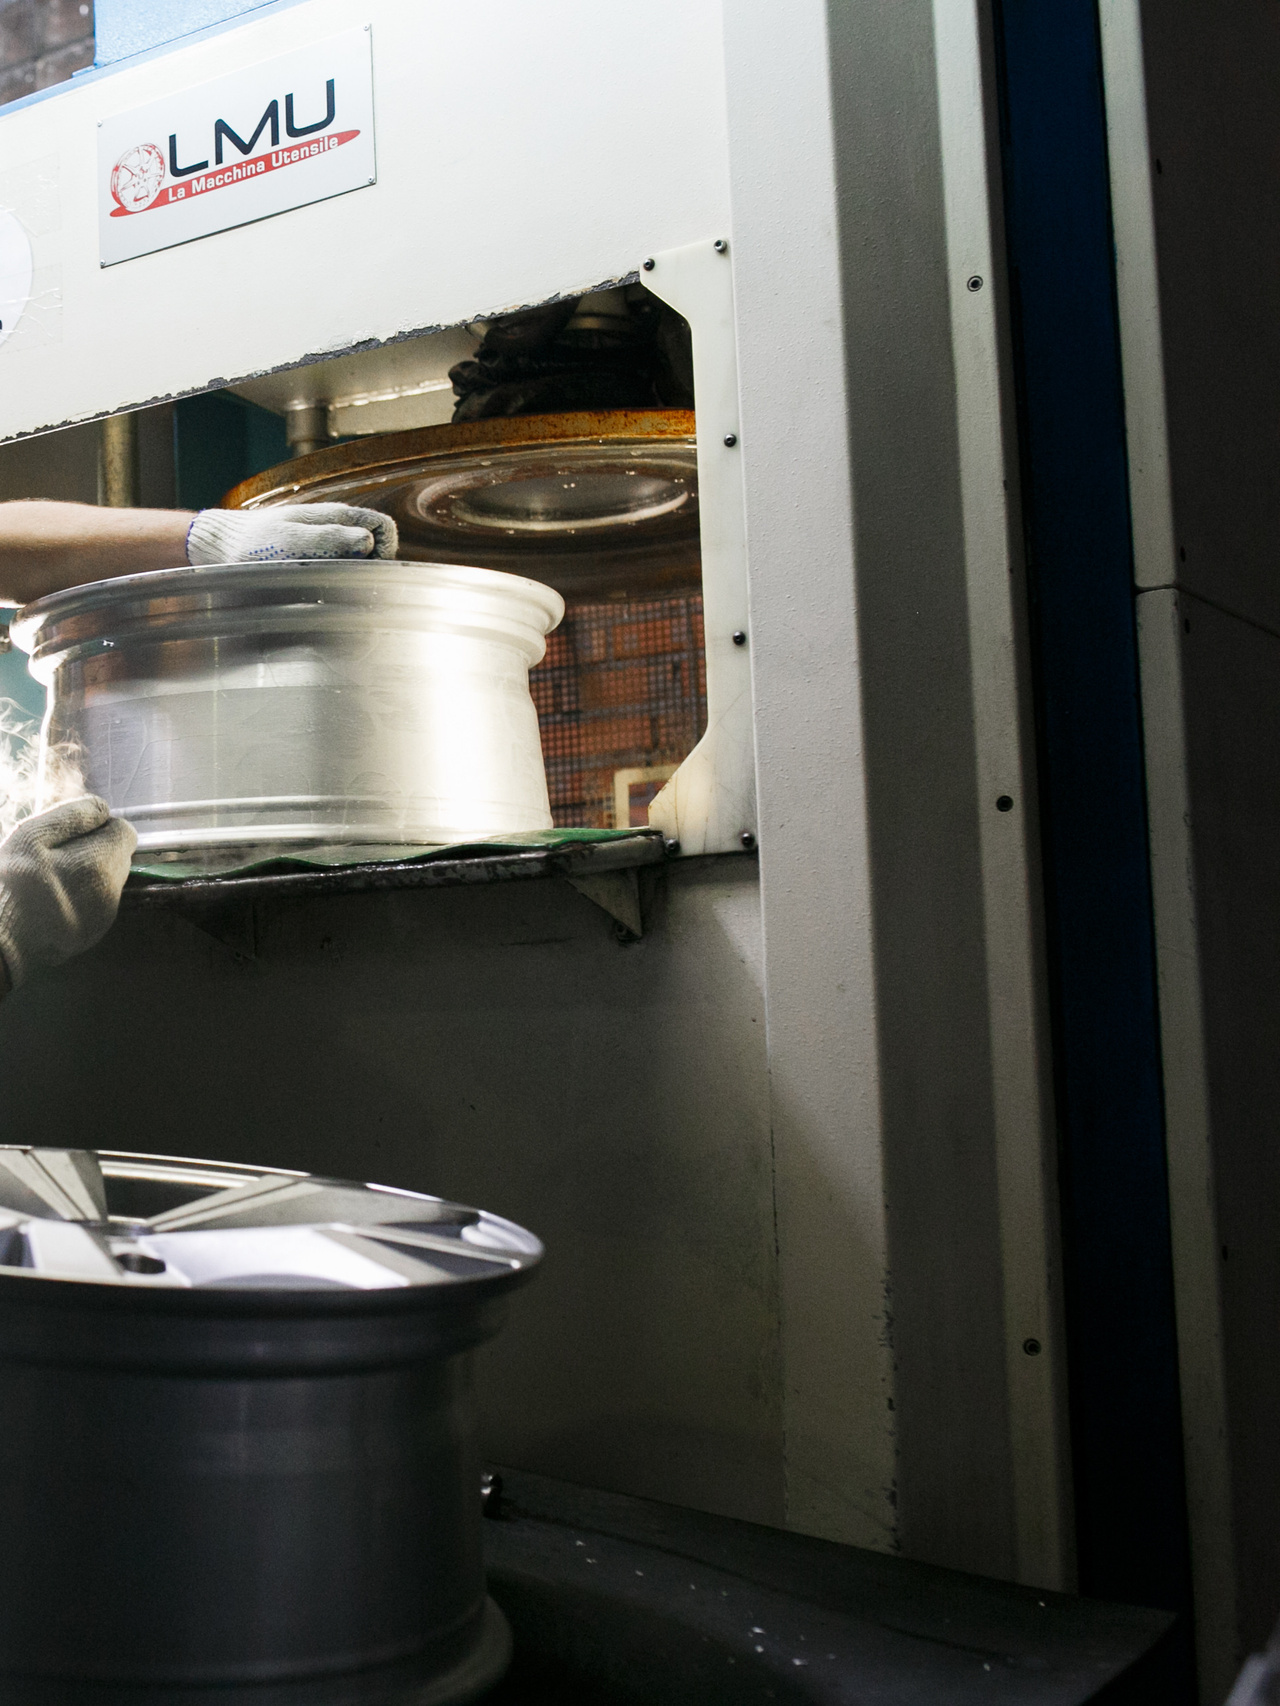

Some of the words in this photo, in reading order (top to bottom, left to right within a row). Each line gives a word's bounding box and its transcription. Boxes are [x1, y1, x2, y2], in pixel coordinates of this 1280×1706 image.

[168, 185, 185, 202] La
[192, 161, 265, 194] Macchina
[272, 135, 339, 168] Utensile
[169, 79, 335, 177] LMU
